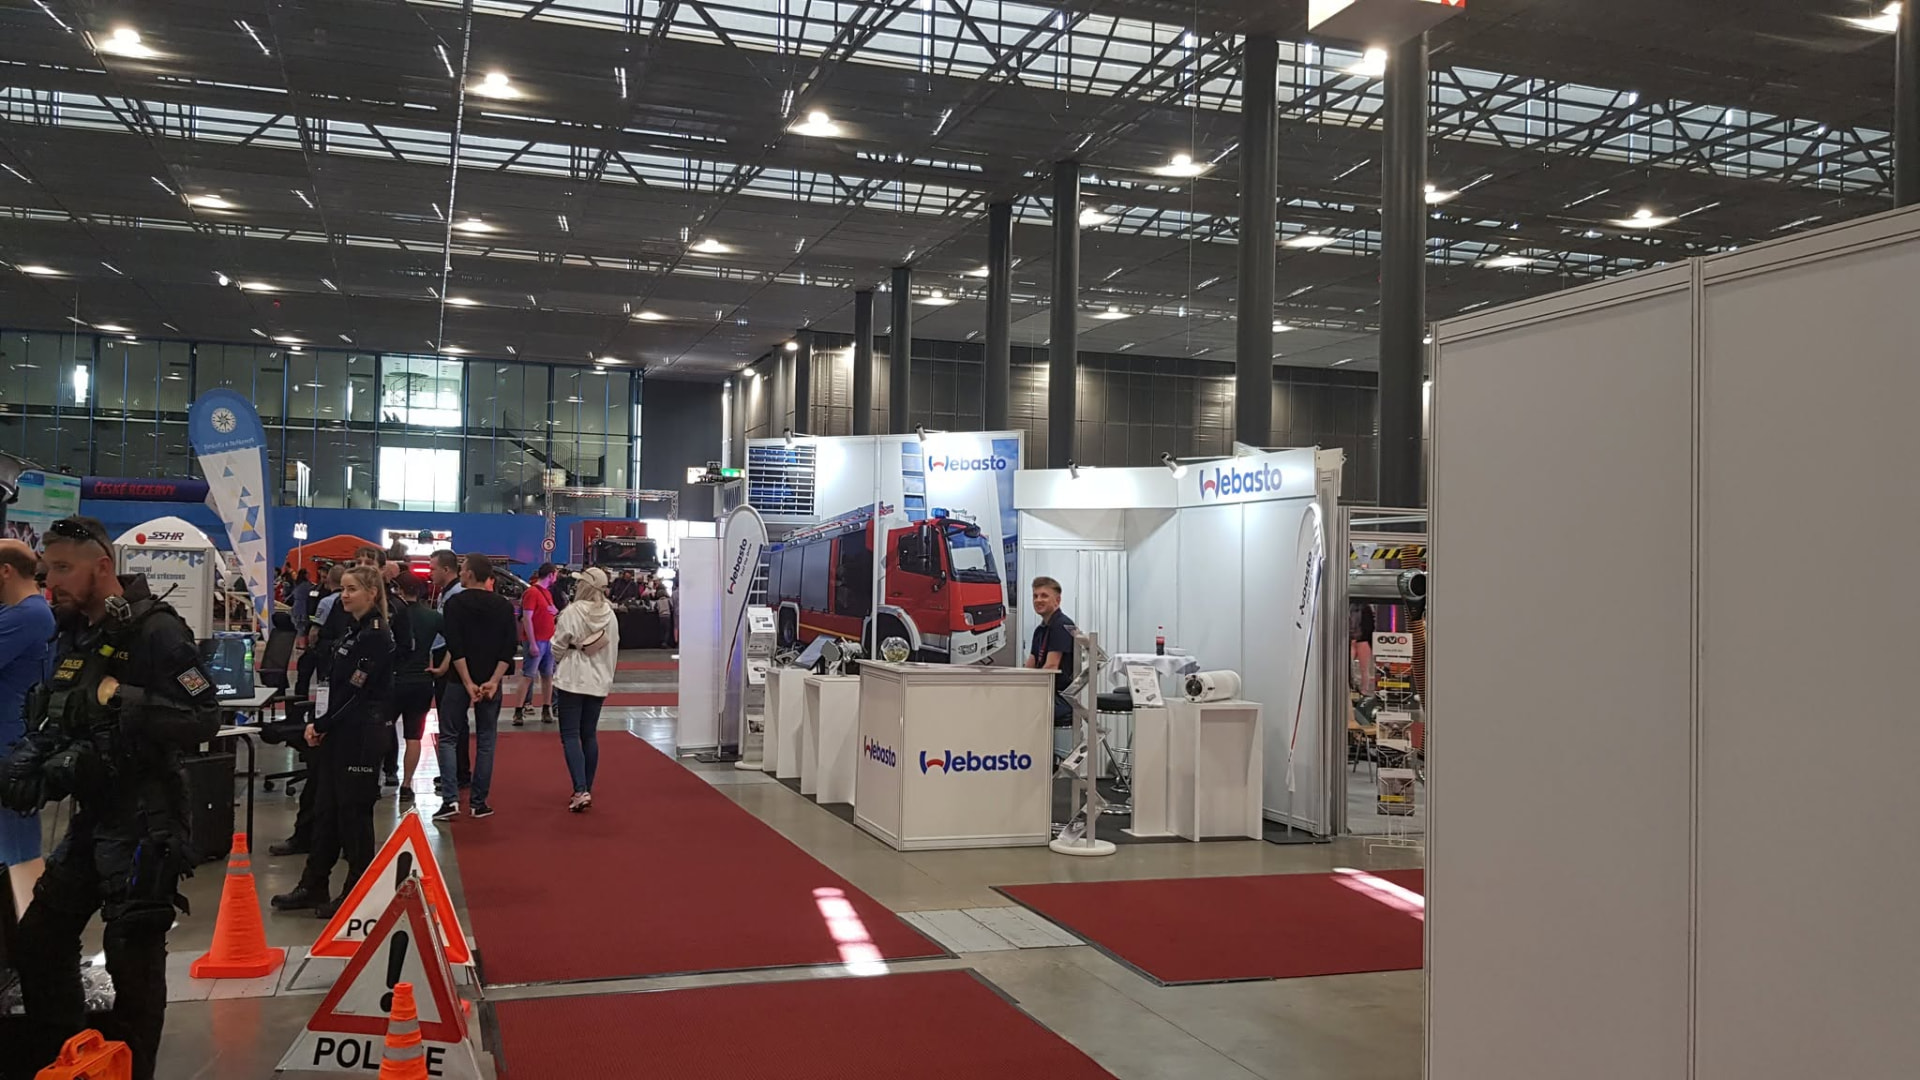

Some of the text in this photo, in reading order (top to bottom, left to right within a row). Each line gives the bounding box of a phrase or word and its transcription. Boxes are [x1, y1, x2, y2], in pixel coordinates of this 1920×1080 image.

[928, 455, 1007, 473] Webasto
[1199, 462, 1283, 500] Webasto
[148, 531, 185, 541] SSHR
[727, 538, 748, 595] Webasto
[863, 735, 897, 768] Webasto
[919, 749, 1032, 775] Webasto
[313, 1037, 446, 1076] POLE
